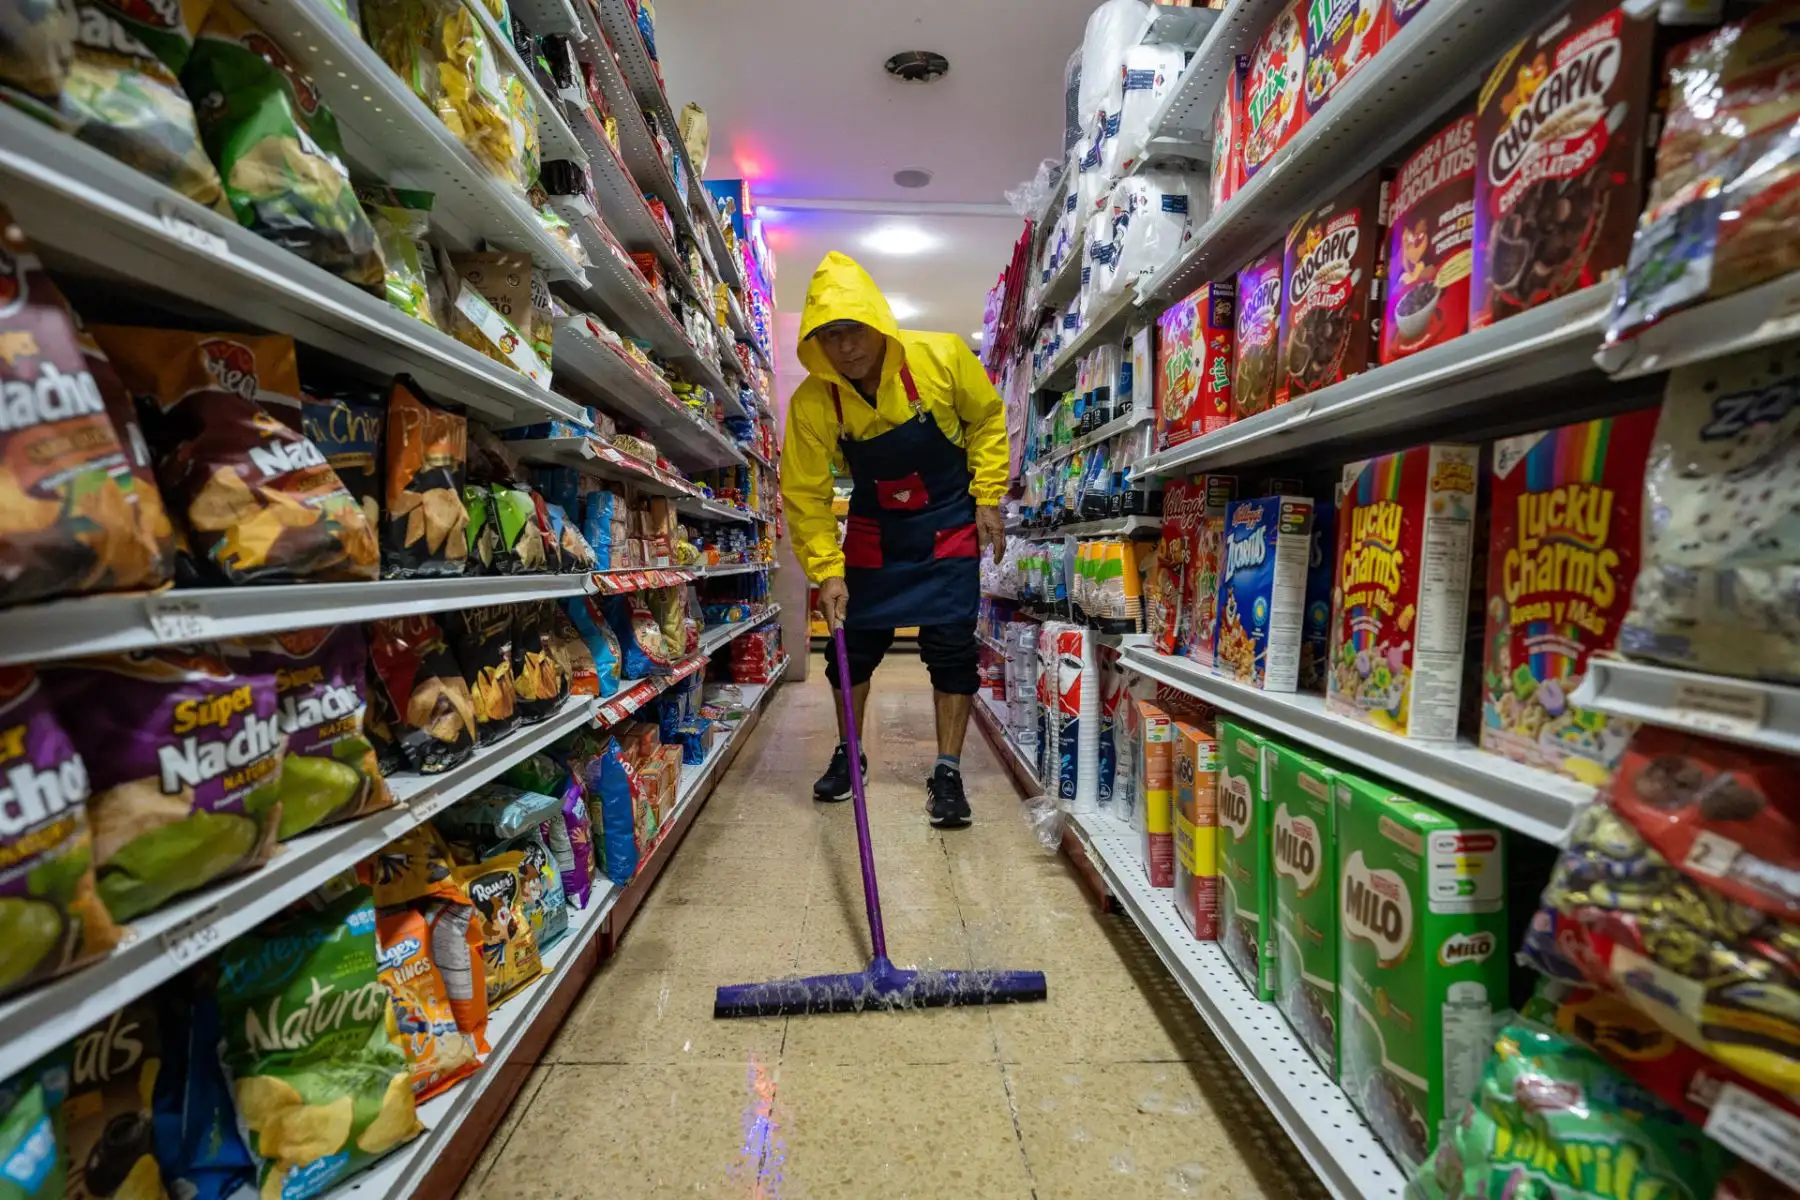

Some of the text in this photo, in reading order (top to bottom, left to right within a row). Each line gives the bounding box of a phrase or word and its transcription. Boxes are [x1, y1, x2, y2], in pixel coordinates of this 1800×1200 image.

[1249, 64, 1288, 130] Trix
[1493, 46, 1616, 182] CHOCAPIC
[1401, 118, 1475, 190] AHORA MÁS
[1291, 228, 1356, 303] CHOCAPIC
[1237, 279, 1280, 343] CHOCAPIC
[1166, 350, 1193, 390] Trix
[1209, 356, 1231, 393] Trix
[1112, 495, 1119, 504] 12
[1124, 491, 1133, 500] 12
[1517, 484, 1614, 551] Lucky
[1351, 500, 1405, 551] Lucky
[1342, 545, 1405, 597] Charms
[1503, 543, 1619, 608] Charms
[174, 685, 253, 734] Super
[1220, 785, 1248, 826] MILO
[1275, 823, 1315, 877] MILO
[1346, 874, 1403, 944] MILO
[393, 957, 432, 986] RINGS
[1446, 941, 1491, 958] MILO
